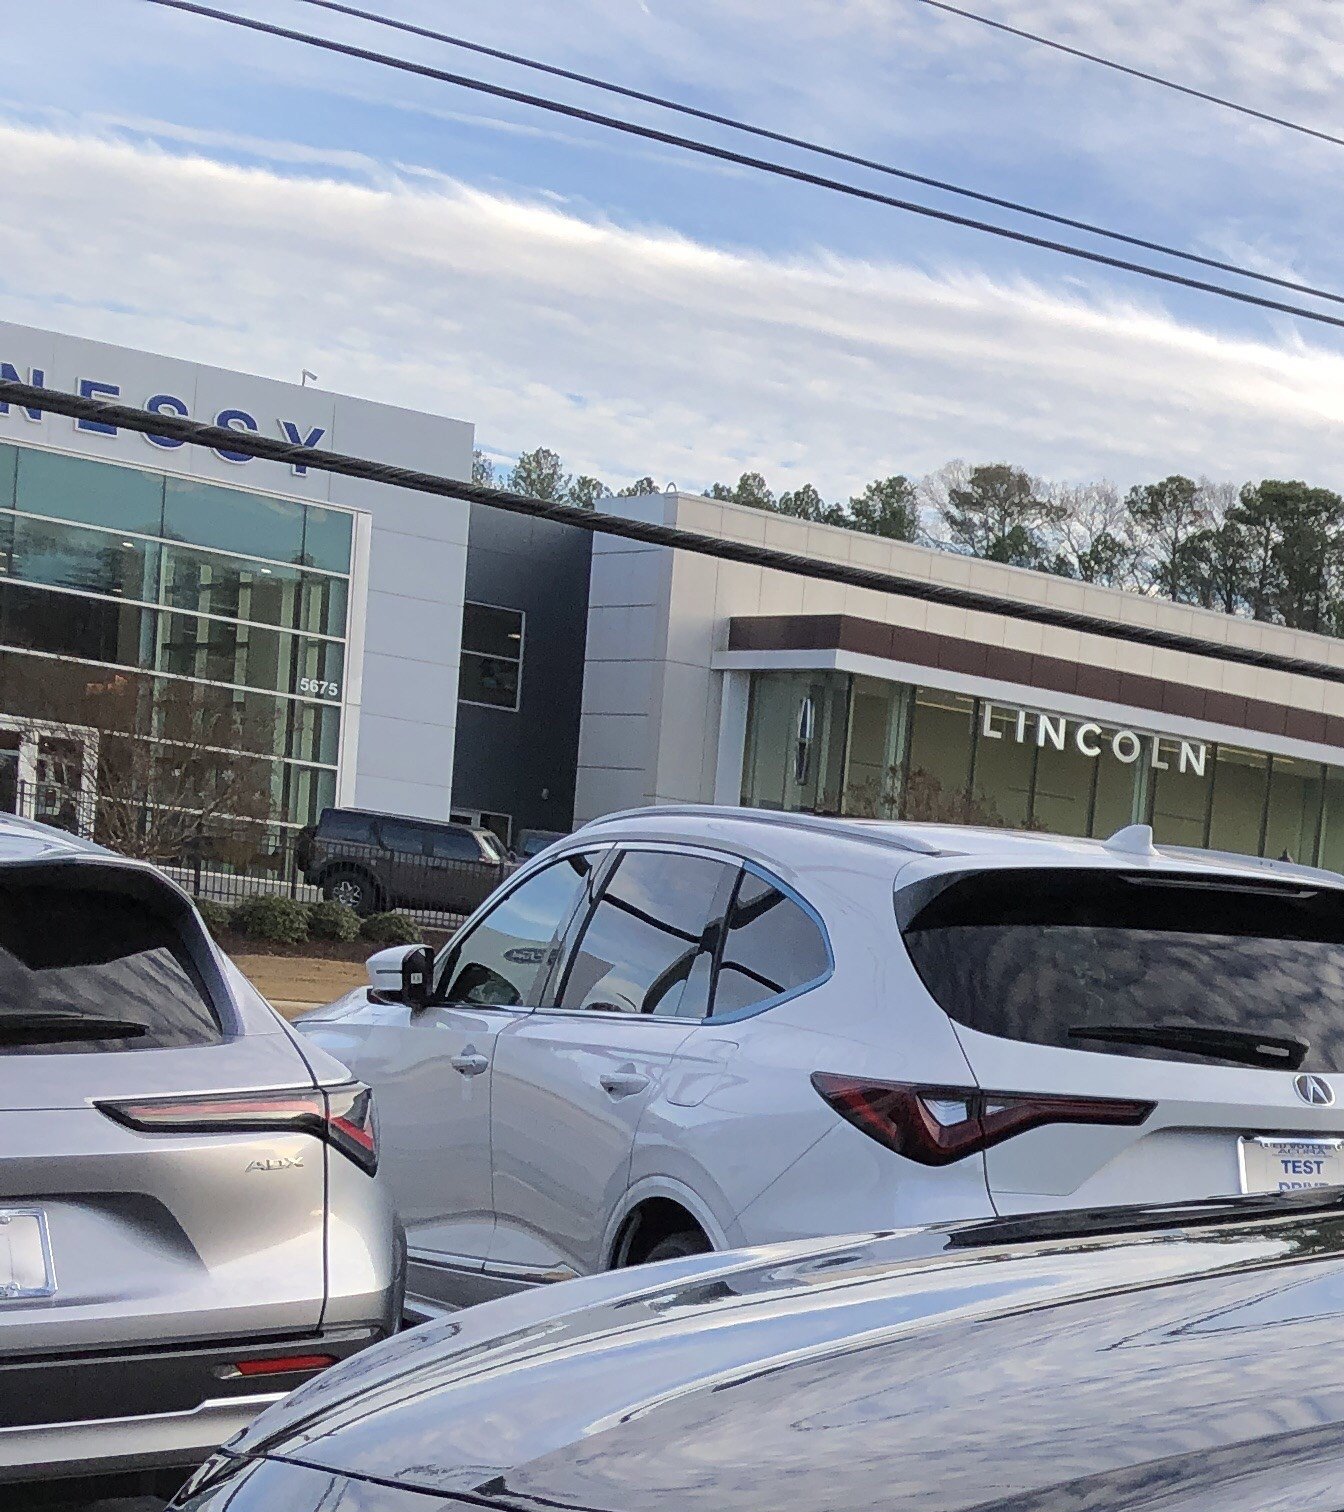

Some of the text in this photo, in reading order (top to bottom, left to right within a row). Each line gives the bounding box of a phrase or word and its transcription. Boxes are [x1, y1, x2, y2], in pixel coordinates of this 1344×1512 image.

[300, 677, 338, 696] 5675
[982, 702, 1207, 776] LINCOLN
[1281, 1160, 1324, 1174] TEST
